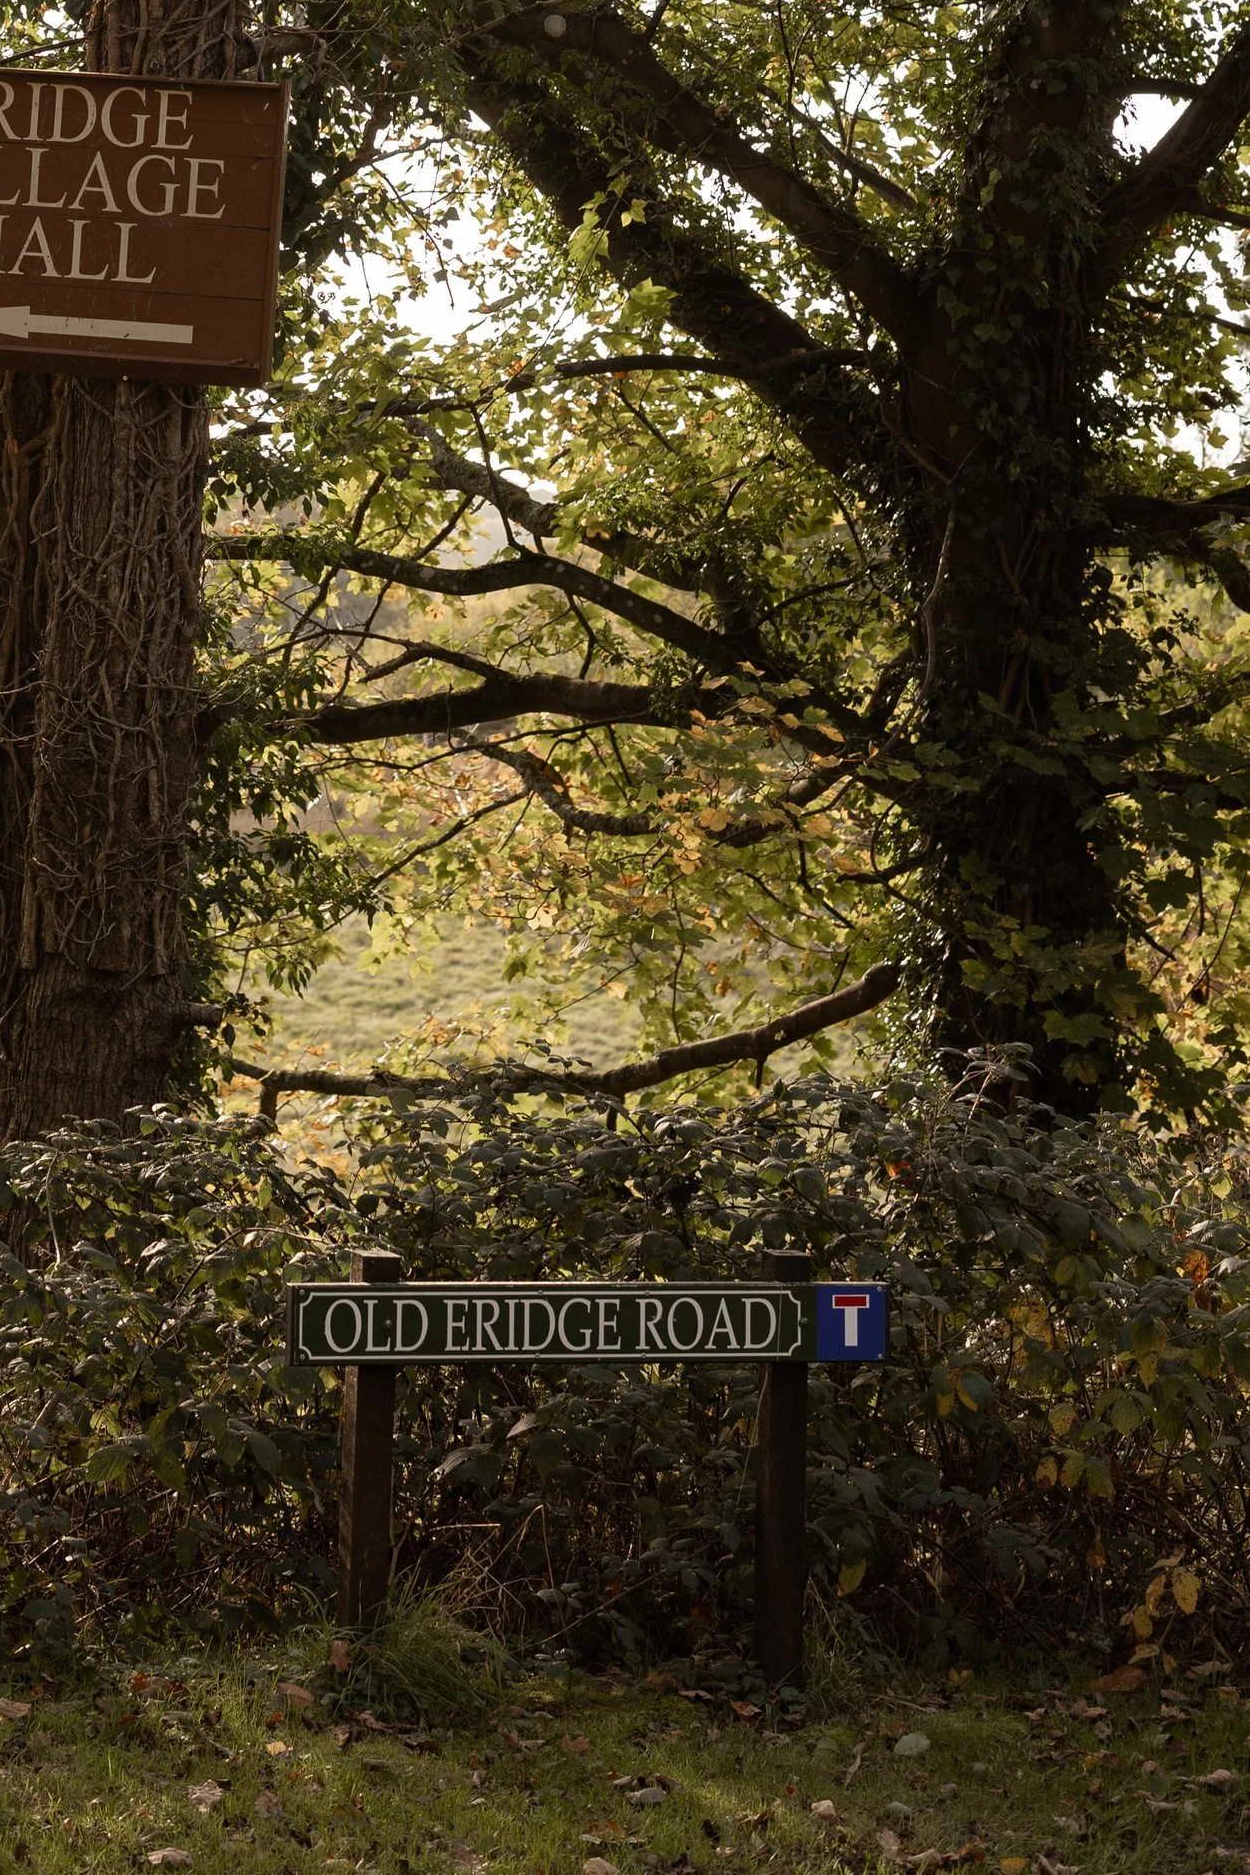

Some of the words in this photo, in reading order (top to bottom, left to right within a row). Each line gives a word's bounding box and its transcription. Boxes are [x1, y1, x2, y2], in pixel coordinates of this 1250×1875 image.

[324, 1298, 429, 1354] OLD
[443, 1298, 622, 1353] ERIDGE
[635, 1297, 778, 1351] ROAD
